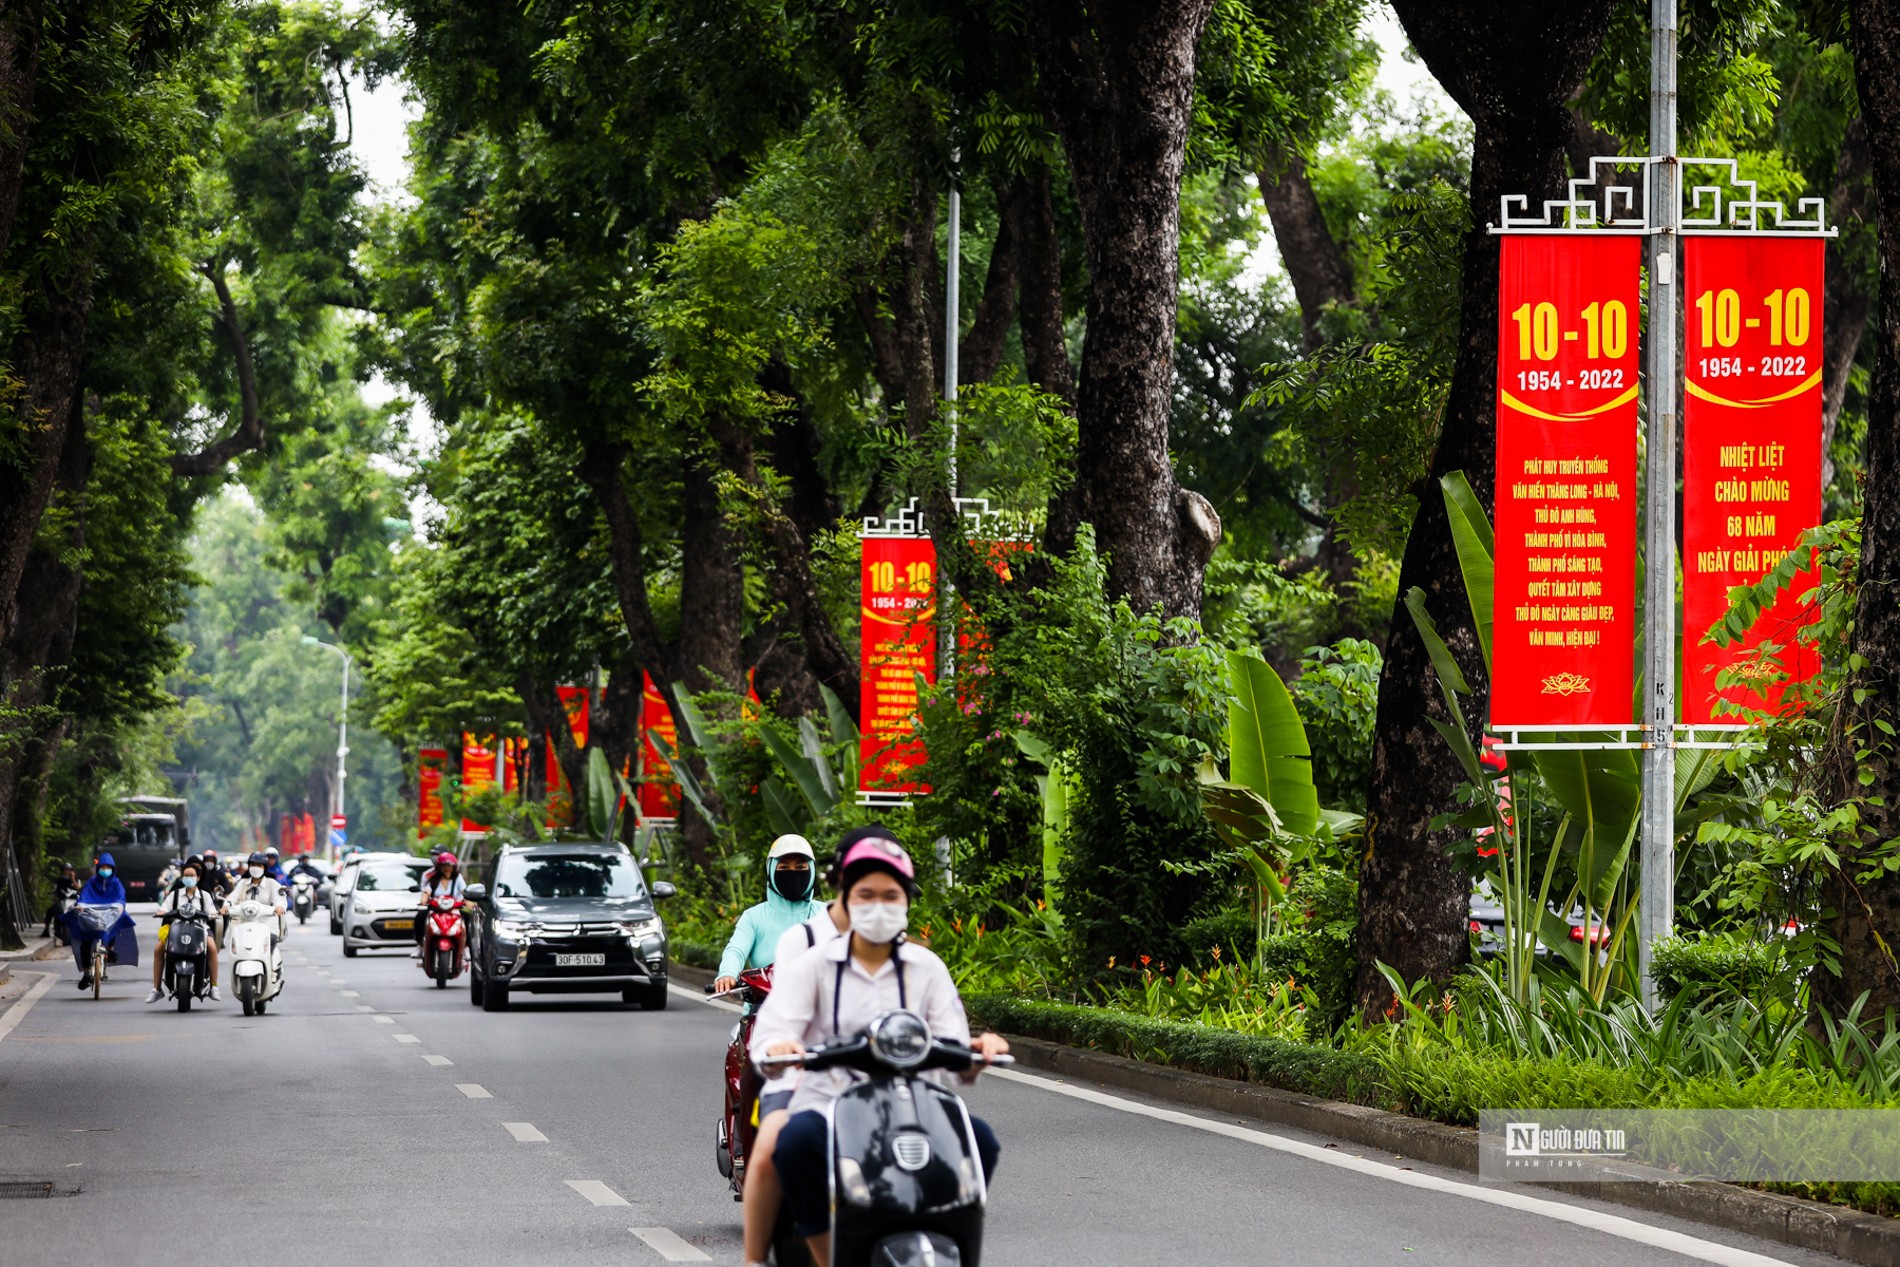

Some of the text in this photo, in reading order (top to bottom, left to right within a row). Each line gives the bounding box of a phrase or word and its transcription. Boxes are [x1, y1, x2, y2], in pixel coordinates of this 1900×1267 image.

[1695, 287, 1810, 348] 10-10
[1512, 300, 1627, 360] 10-10
[1699, 357, 1742, 378] 1954
[1761, 355, 1806, 376] 2022
[1517, 370, 1561, 391] 1954
[1579, 368, 1624, 389] 2022
[1524, 457, 1542, 475] PHÁT
[1543, 460, 1557, 475] HUY
[1585, 454, 1608, 475] THỐNG
[1720, 441, 1785, 473] NHIỆT LIỆT
[1513, 481, 1527, 499] VĂN
[1528, 480, 1545, 499] HIẾN
[1546, 481, 1569, 499] THĂNG
[1570, 484, 1588, 499] LONG
[1593, 481, 1604, 498] HÀ
[1715, 475, 1790, 503] CHÀO MỪNG
[1535, 504, 1596, 525] THỦ ĐÔ ANH HÙNG,
[1727, 510, 1776, 538] 68 NĂM
[1525, 530, 1548, 548] THÀNH
[1549, 528, 1563, 548] PHỐ
[1572, 530, 1586, 547] HÒA
[1587, 530, 1607, 548] BÌNH,
[1528, 553, 1603, 575] THÀNH PHỐ SÁNG TẠO,
[1698, 546, 1731, 573] NGÀY
[1733, 543, 1759, 572] GIẢI
[869, 560, 931, 594] 10-10
[1528, 577, 1602, 600] QUYẾT TÂM XÂY DỰNG
[871, 596, 896, 609] 1954
[1515, 602, 1614, 624] THỦ ĐÔ NGÀY CÀNG GIÀU ĐẸP,
[1529, 628, 1544, 646] VĂN
[1545, 631, 1565, 648] MINH,
[1566, 628, 1582, 649] HIỆN
